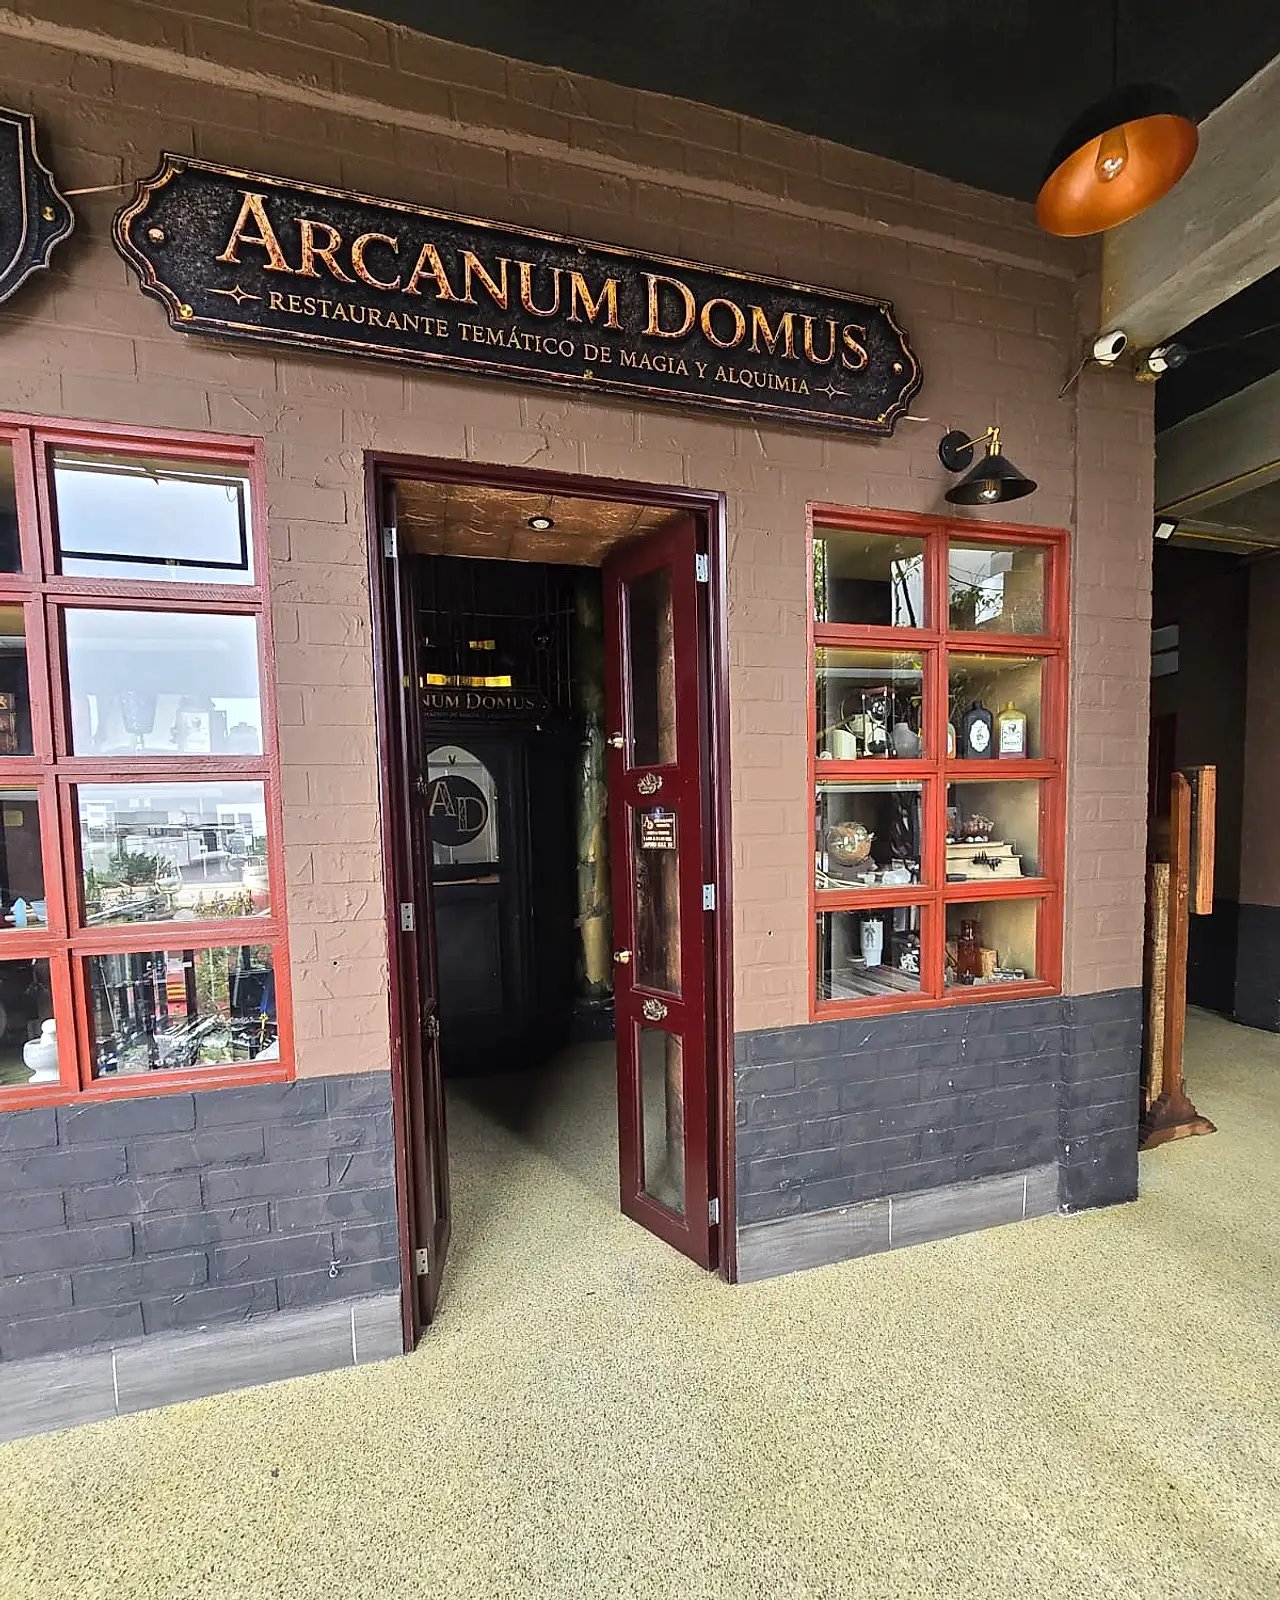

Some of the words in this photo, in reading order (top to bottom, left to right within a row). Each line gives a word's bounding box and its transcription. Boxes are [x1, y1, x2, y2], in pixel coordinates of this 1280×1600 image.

[215, 190, 624, 330] ARCANUM
[641, 272, 868, 372] DOMUS
[269, 292, 449, 338] RESTAURANTE
[458, 323, 575, 358] TEMÁTICO
[583, 344, 612, 363] DE
[620, 350, 690, 377] MAGIA
[695, 362, 709, 379] Y
[715, 366, 811, 396] ALQUIMIA
